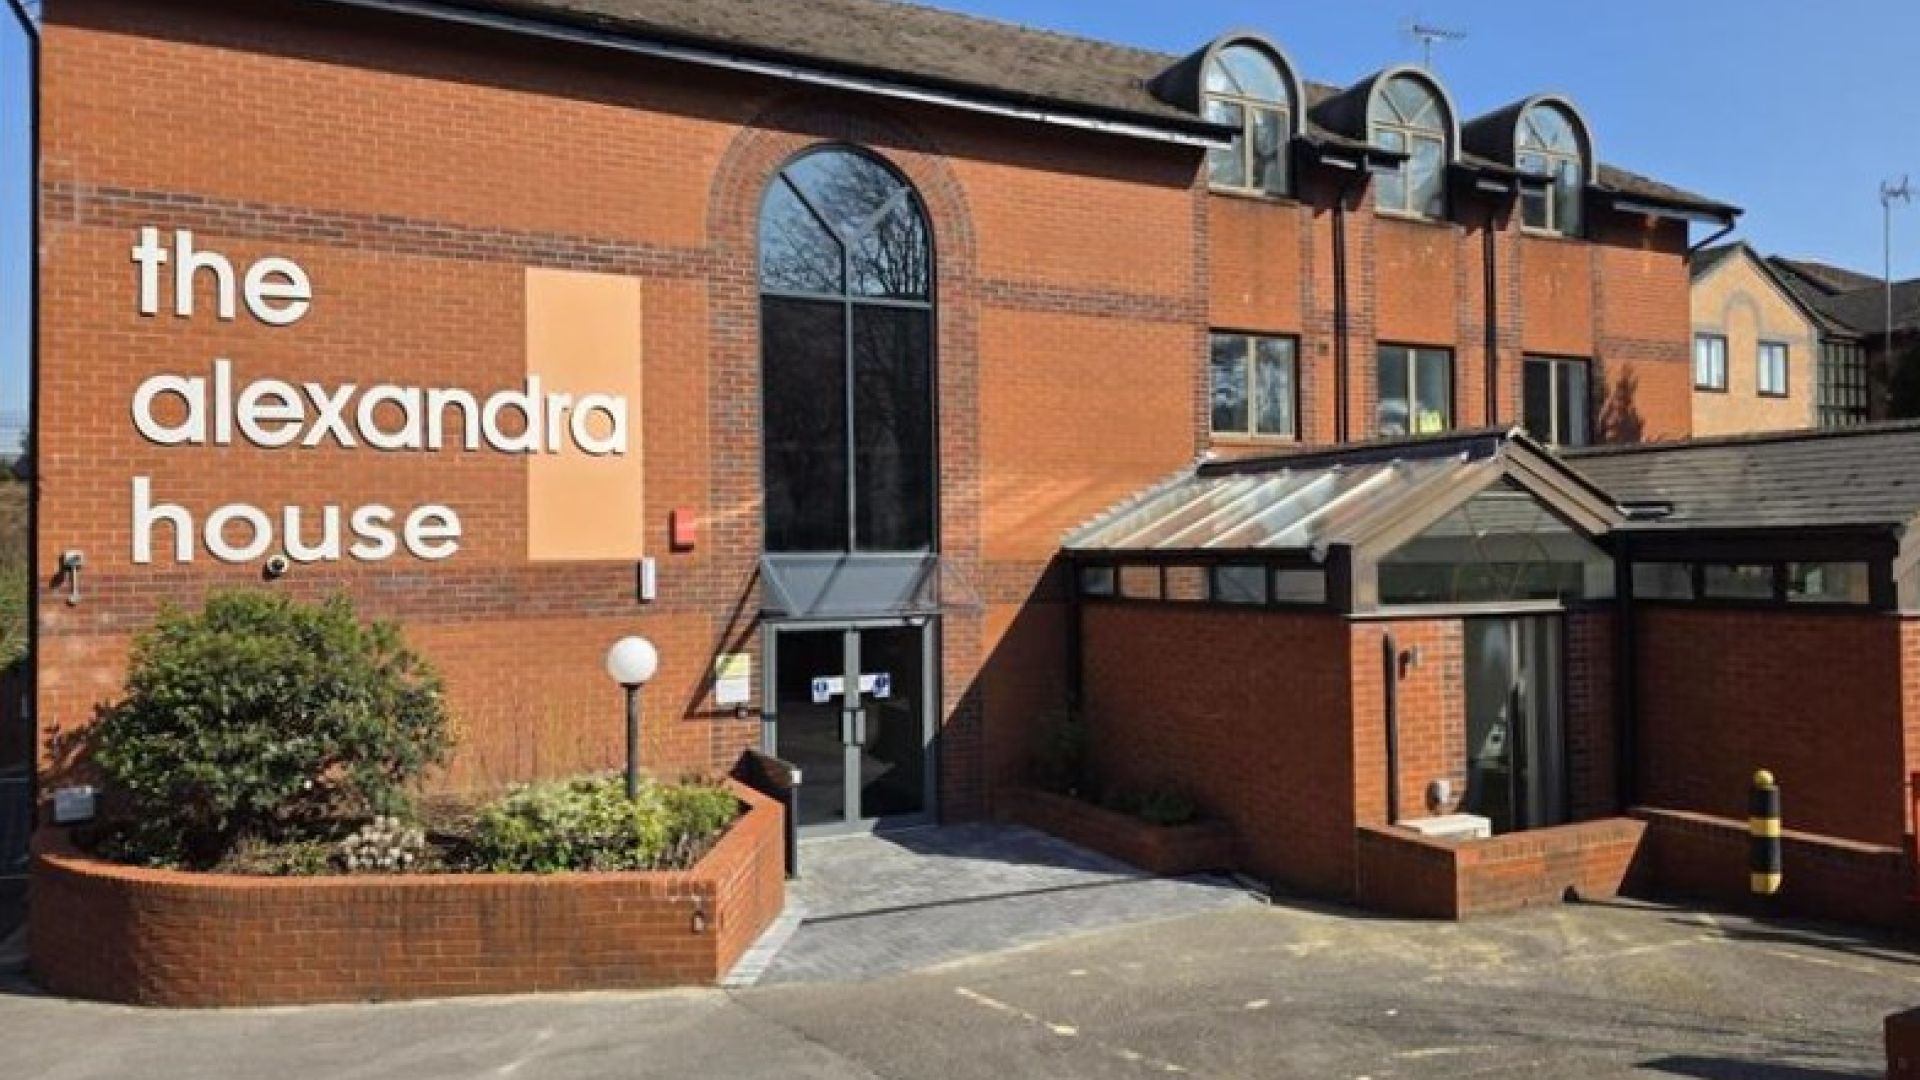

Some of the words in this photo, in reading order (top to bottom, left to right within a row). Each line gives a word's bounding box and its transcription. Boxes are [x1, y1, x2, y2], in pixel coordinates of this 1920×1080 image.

[131, 227, 312, 325] the
[131, 360, 628, 455] alexandra
[131, 477, 462, 564] house
